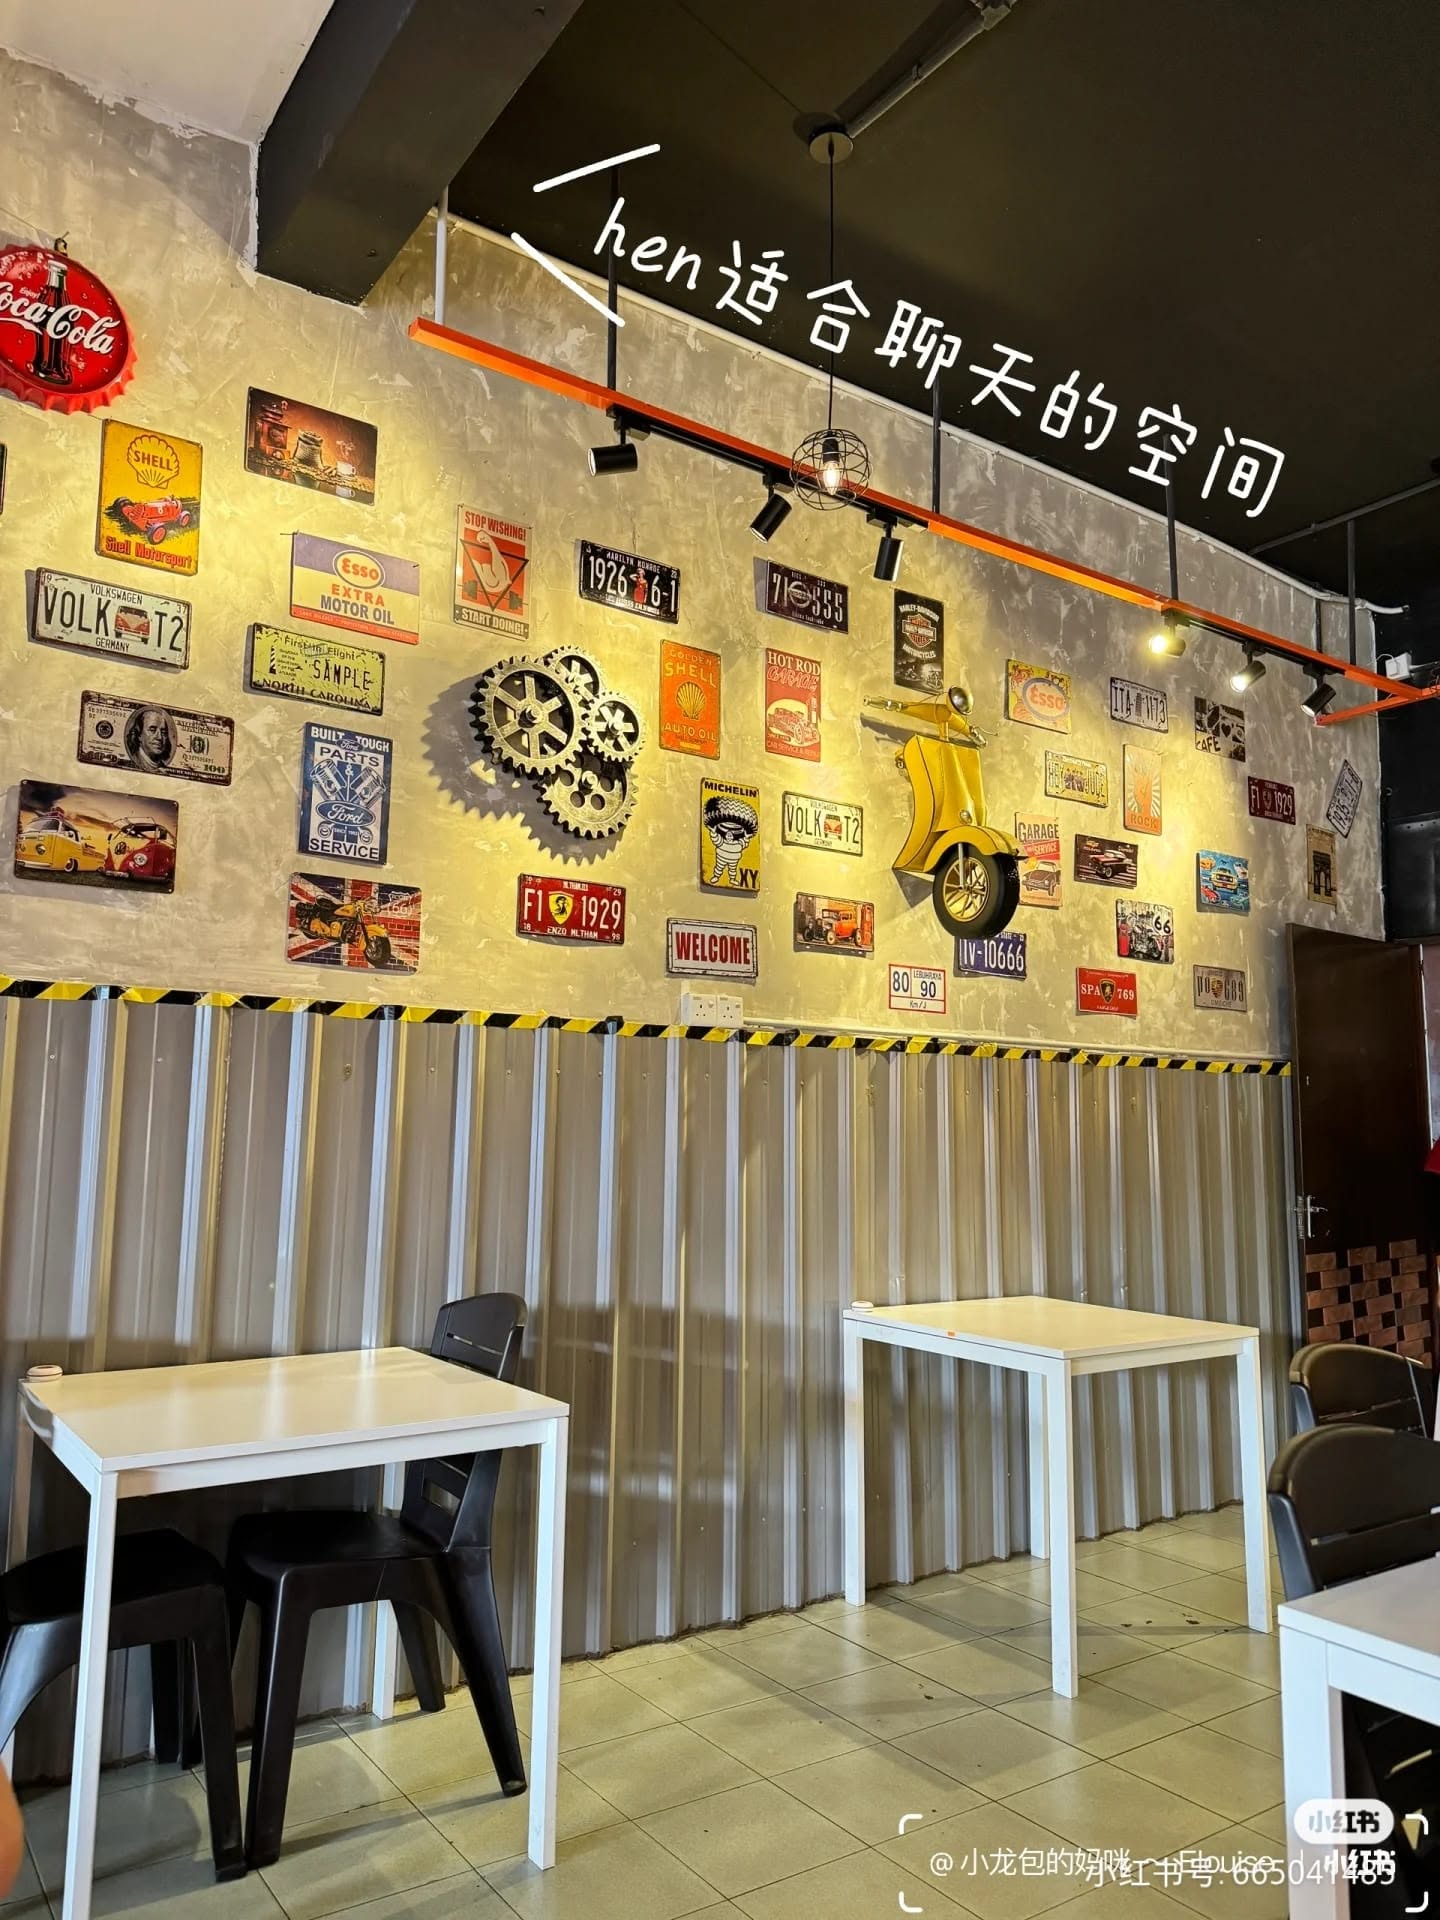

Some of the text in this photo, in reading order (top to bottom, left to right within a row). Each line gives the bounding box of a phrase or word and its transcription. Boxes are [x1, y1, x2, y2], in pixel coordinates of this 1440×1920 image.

[133, 450, 174, 472] SHELL
[465, 511, 527, 542] STOP WISHING!
[105, 536, 193, 570] Shell Motorsport
[606, 551, 661, 574] MARILYN MONROE
[91, 583, 143, 606] VOLKSWAGEN
[331, 583, 385, 607] EXTRA
[589, 555, 676, 613] 1926 6-1
[43, 586, 184, 652] VOLK T2
[320, 594, 369, 620] MOTOR
[372, 608, 395, 625] OIL
[461, 609, 524, 635] START DOING!
[95, 637, 130, 653] GERMANY
[284, 635, 308, 650] First
[670, 649, 713, 665] GOLDEN
[768, 651, 820, 676] HOT ROD
[312, 659, 372, 691] SAMPLE
[664, 662, 717, 688] SHELL
[767, 665, 820, 693] GARAGE
[262, 678, 372, 711] NORTH CAROLINA
[310, 726, 345, 742] BUILT
[355, 735, 390, 753] TOUGH
[664, 722, 696, 737] AUTO
[698, 729, 717, 741] OIL
[319, 746, 380, 767] PARTS
[344, 764, 354, 777] &
[704, 780, 757, 798] MICHELIN
[327, 803, 366, 825] Ford
[1274, 790, 1293, 817] 1929
[786, 804, 860, 844] VOLK T2
[1018, 821, 1059, 843] GARAGE
[1130, 813, 1158, 829] ROCK
[309, 838, 379, 860] SERVICE
[1034, 842, 1058, 856] SERVICE
[740, 867, 759, 889] XY
[523, 887, 622, 930] F1 1929
[547, 926, 567, 936] ENZO
[1154, 916, 1171, 934] 66
[675, 931, 751, 965] WELCOME
[893, 970, 910, 993] 80
[920, 980, 936, 998] 90
[1081, 983, 1135, 1001] SPA 769
